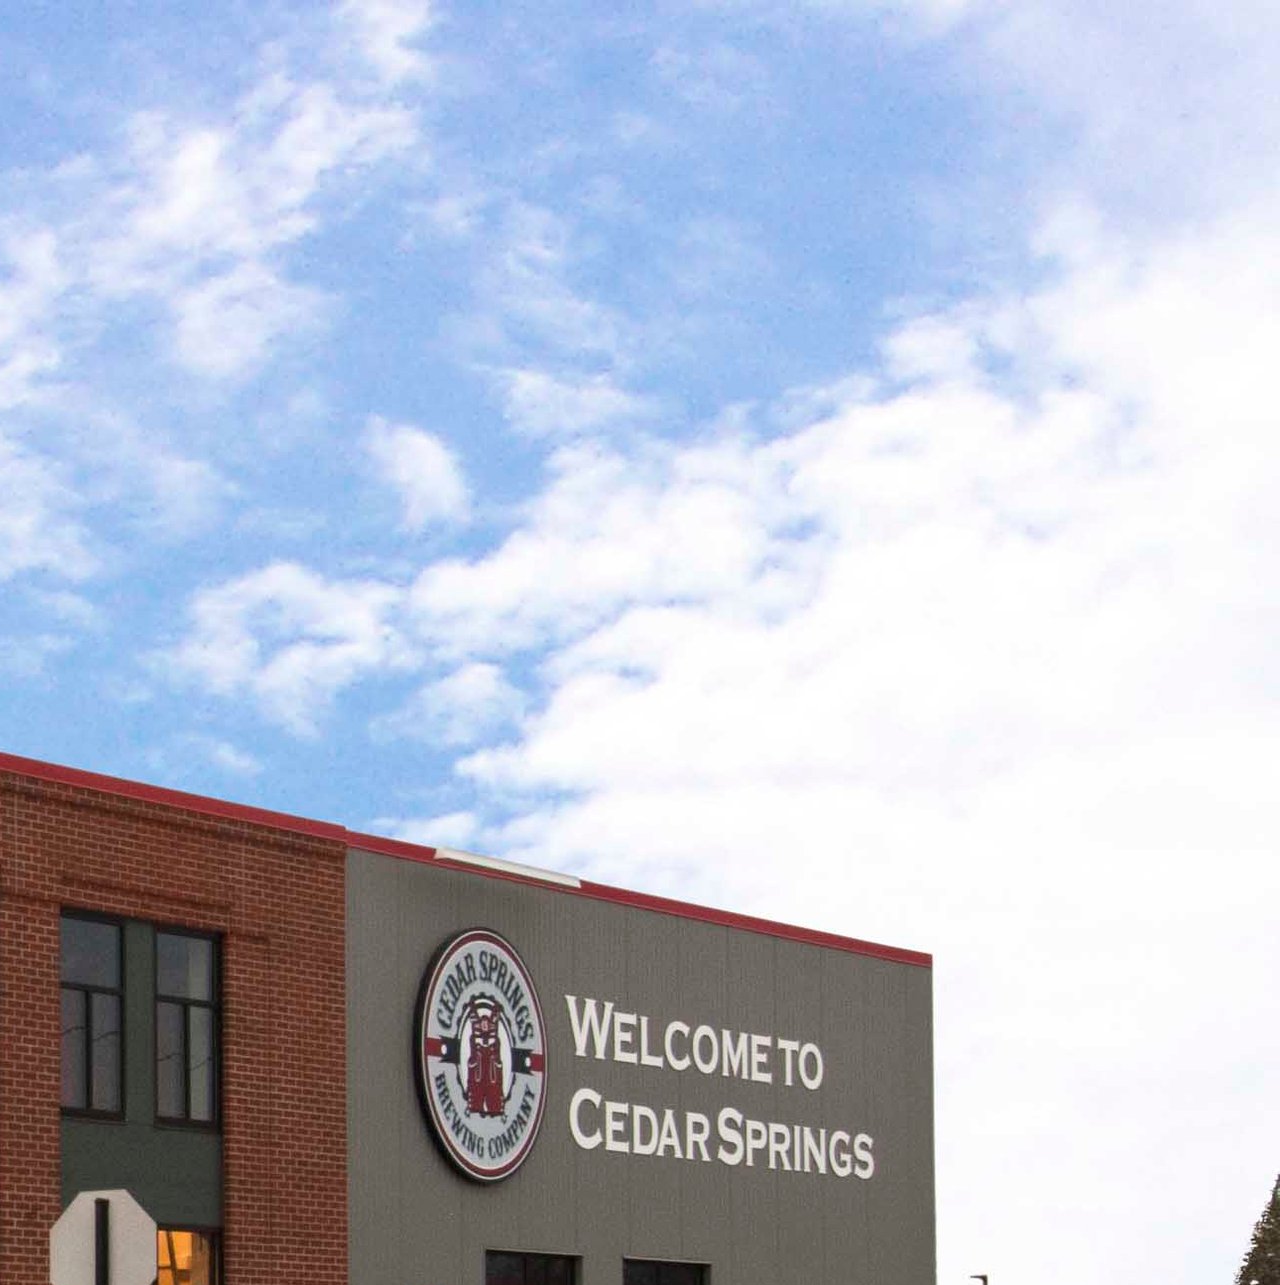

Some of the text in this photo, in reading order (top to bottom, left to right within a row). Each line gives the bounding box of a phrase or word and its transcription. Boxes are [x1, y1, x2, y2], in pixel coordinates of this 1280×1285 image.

[436, 951, 533, 1043] CEDAR SPRINGS
[565, 994, 823, 1090] WELCOME TO
[434, 1073, 536, 1159] BREWING COMPANY
[569, 1087, 875, 1180] CEDAR SPRINGS
